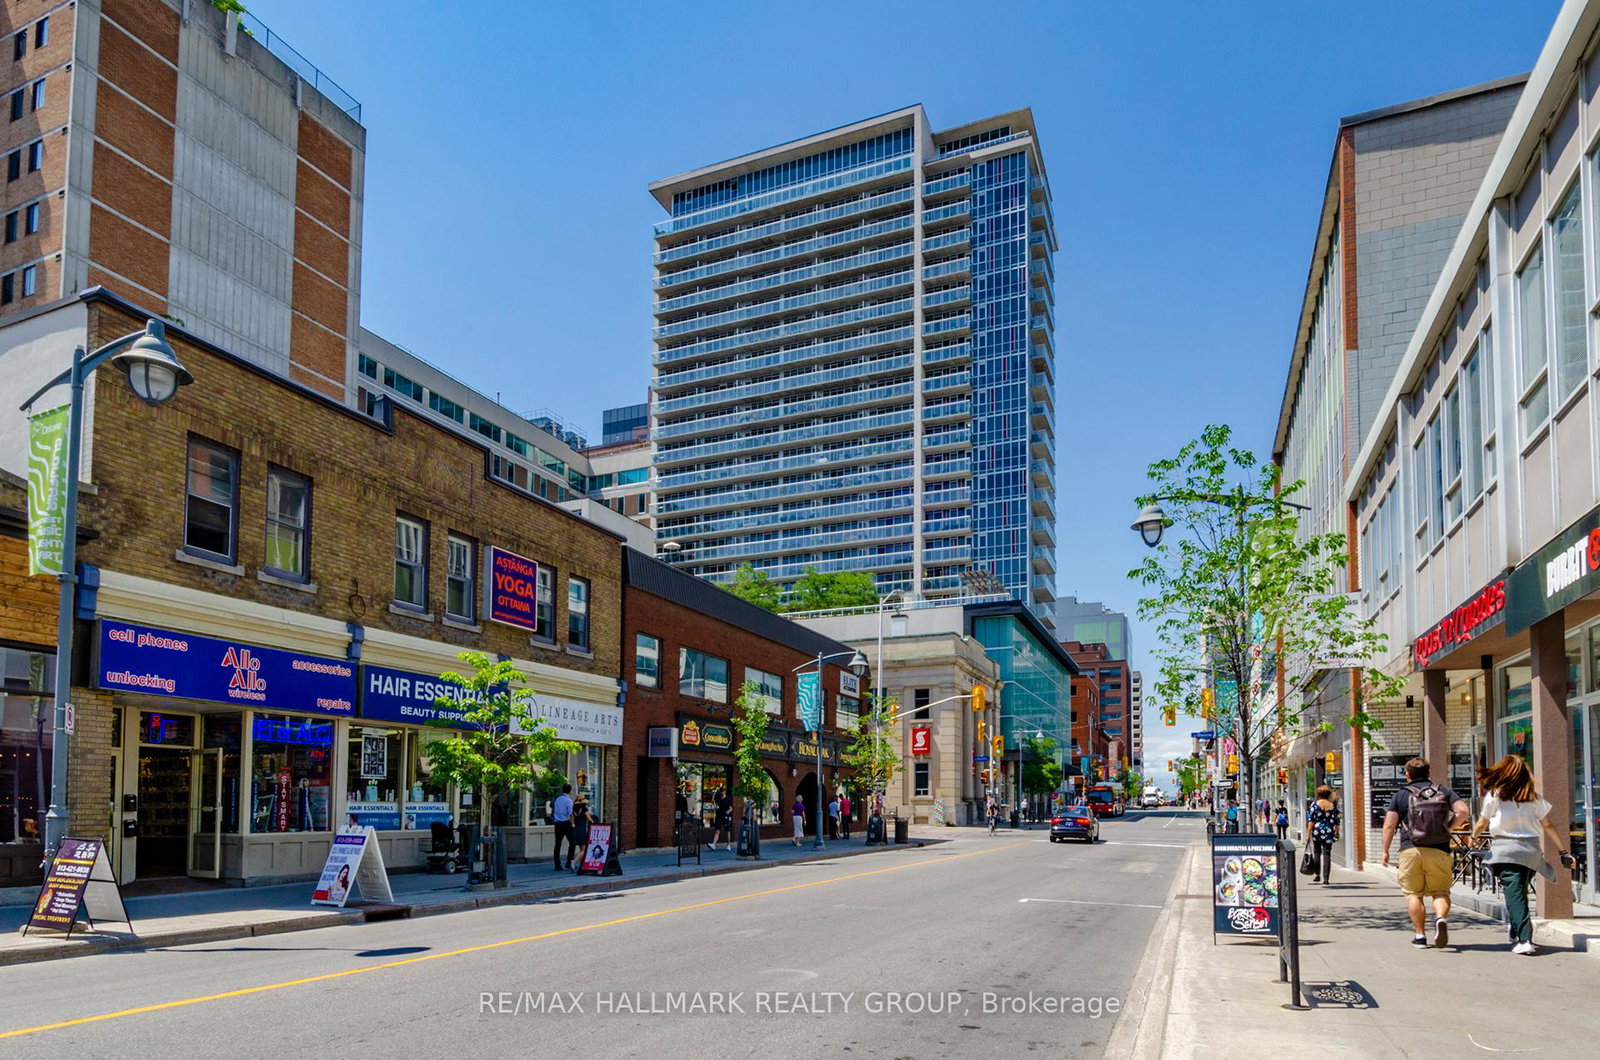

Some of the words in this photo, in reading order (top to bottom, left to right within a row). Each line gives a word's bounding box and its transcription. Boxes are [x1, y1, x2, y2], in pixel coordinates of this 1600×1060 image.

[495, 572, 535, 600] YOGA
[497, 595, 531, 613] OTTAWA
[109, 629, 135, 643] cell
[138, 633, 188, 652] phones
[221, 647, 260, 671] Allo
[292, 660, 352, 677] accessories
[106, 671, 175, 693] unlocking
[229, 668, 267, 690] Allo
[370, 673, 410, 698] HAIR
[228, 688, 266, 701] wireless
[316, 698, 351, 711] repairs
[400, 706, 436, 718] BEAUTY
[438, 711, 467, 721] SUPPL
[541, 704, 589, 722] LINEAGE
[594, 713, 619, 727] ARTS
[280, 775, 288, 799] STAY
[279, 801, 288, 831] SMART
[363, 803, 394, 811] ESSENTIALS
